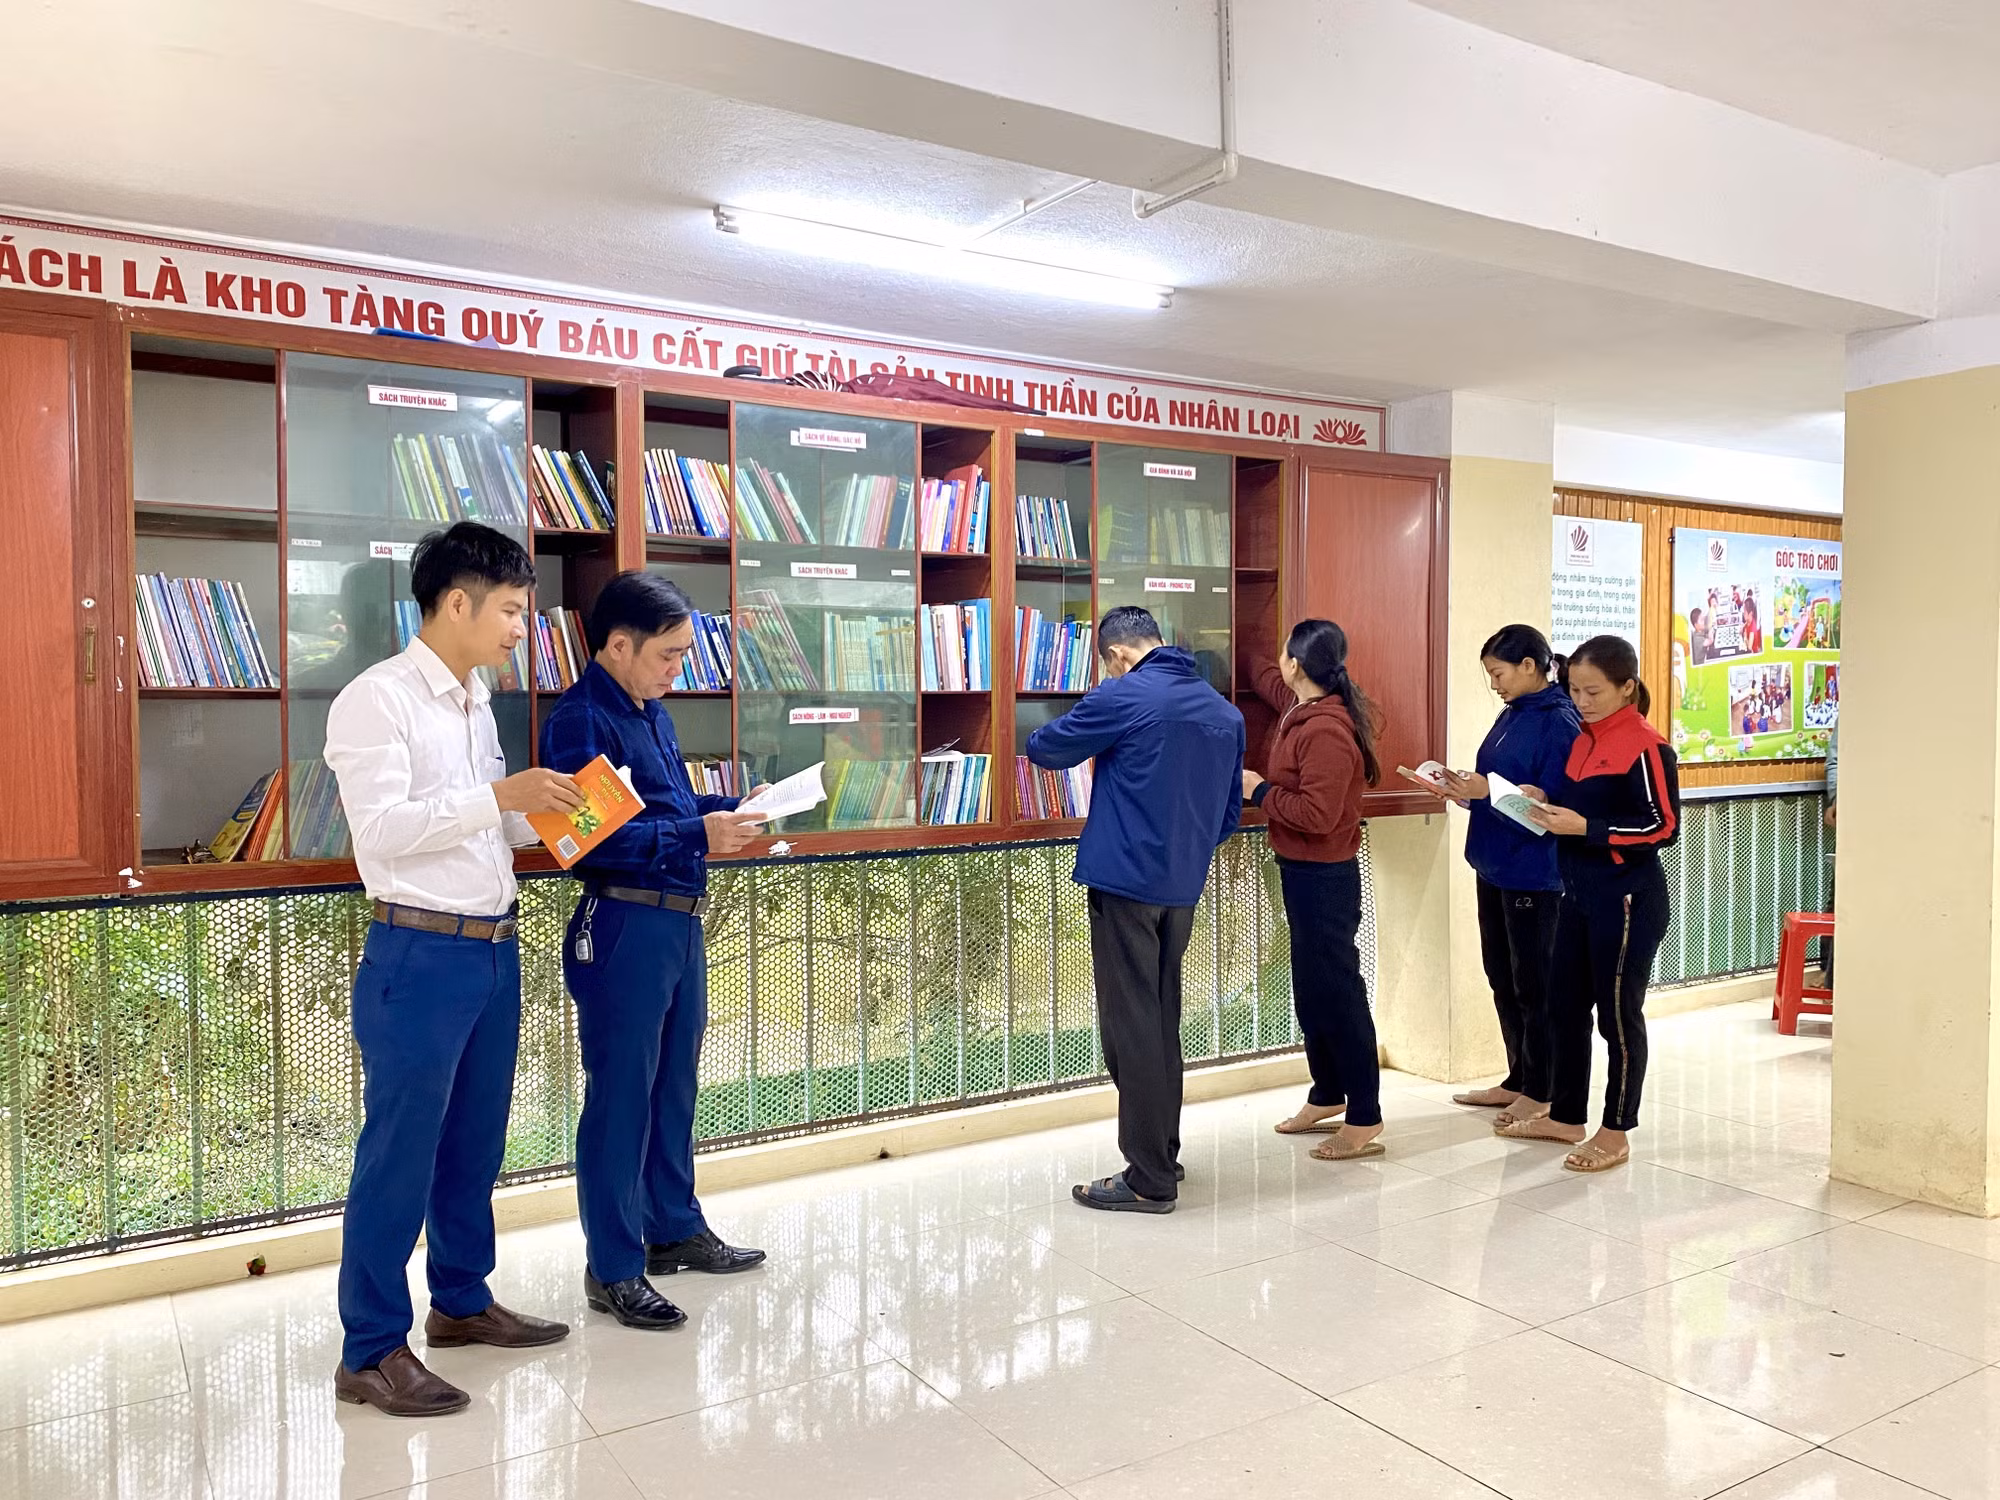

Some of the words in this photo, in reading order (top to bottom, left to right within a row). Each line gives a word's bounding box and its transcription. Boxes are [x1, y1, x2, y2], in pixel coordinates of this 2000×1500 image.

[123, 256, 188, 304] LÀ
[205, 271, 307, 318] KHO
[322, 284, 446, 337] TÀNG
[461, 308, 544, 348] QUÝ
[559, 318, 639, 360] BÁU
[653, 327, 723, 371] CẤT
[735, 343, 798, 378] GIỮ
[806, 350, 858, 383] TÀI
[945, 371, 1014, 405] TINH
[1024, 377, 1098, 417] THẦN
[1107, 386, 1161, 425] CỦA
[1169, 399, 1240, 433] NHÂN
[1248, 409, 1300, 441] LOẠI
[378, 392, 398, 402] SÁCH
[400, 394, 426, 406] TRUYỆN
[428, 396, 447, 407] KHÁC
[374, 545, 392, 555] SÁCH
[1775, 547, 1795, 568] GÓC
[1797, 549, 1815, 570] TRÒ
[1817, 553, 1839, 571] CHƠI
[1557, 588, 1573, 598] trong
[1575, 588, 1585, 599] gia
[1603, 590, 1619, 601] trong
